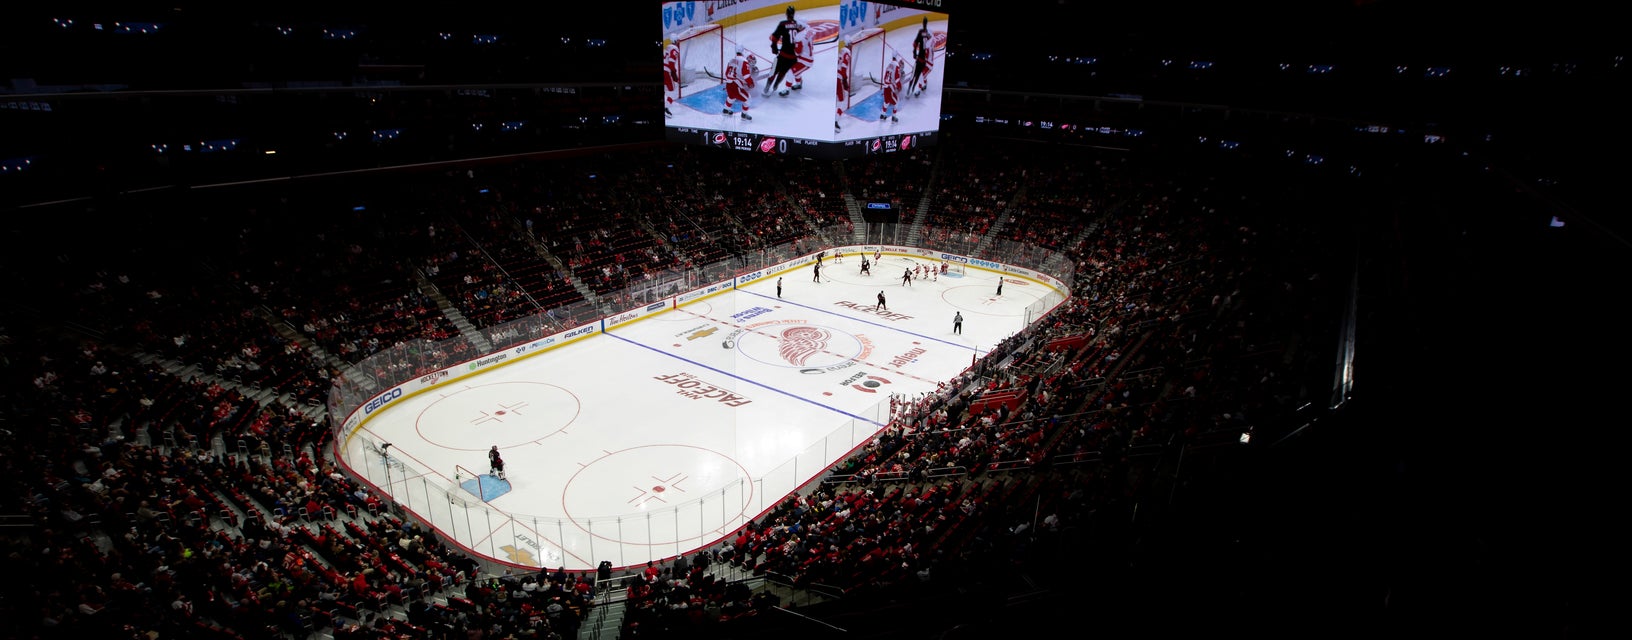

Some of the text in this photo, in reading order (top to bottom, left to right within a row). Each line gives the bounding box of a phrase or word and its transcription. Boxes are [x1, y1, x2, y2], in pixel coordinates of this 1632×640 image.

[733, 137, 752, 147] 19:14
[779, 139, 787, 153] 0
[941, 253, 968, 264] GEICO
[564, 325, 594, 339] FALKEN
[477, 353, 507, 367] Huntington
[839, 371, 868, 387] BELFOR
[364, 387, 402, 414] GEICO
[676, 389, 702, 400] NHL
